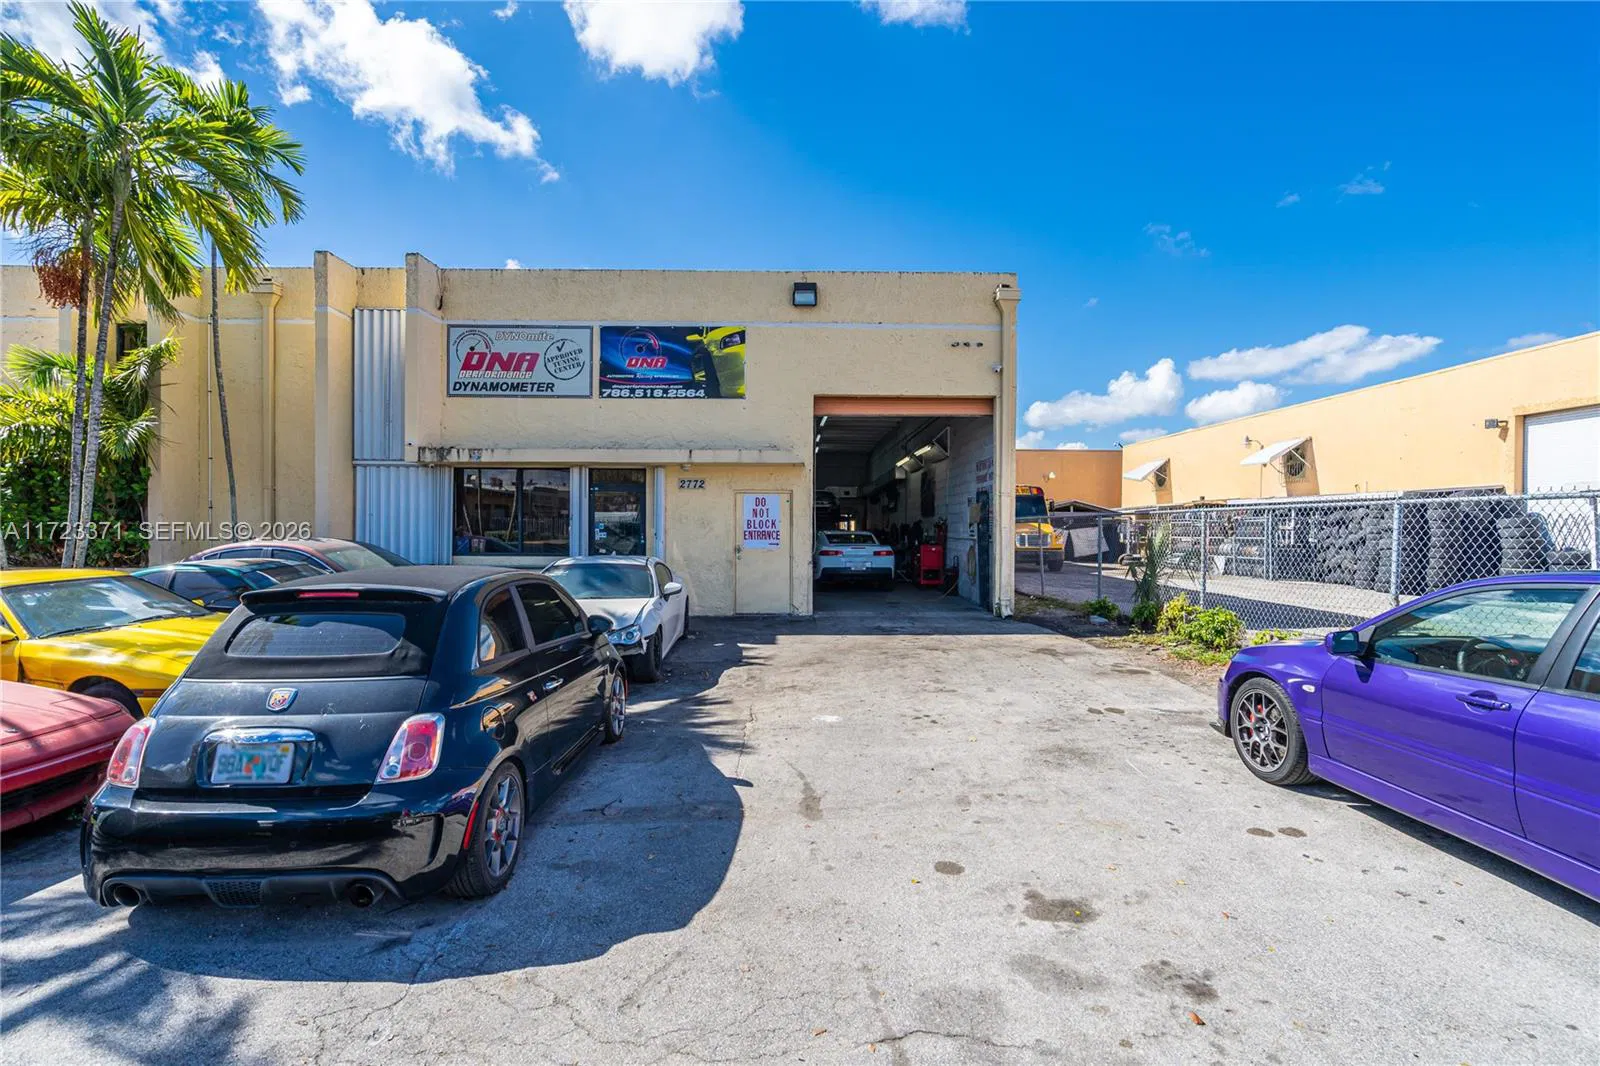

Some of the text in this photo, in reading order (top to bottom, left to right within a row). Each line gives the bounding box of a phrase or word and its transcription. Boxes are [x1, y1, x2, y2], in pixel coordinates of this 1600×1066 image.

[546, 348, 583, 363] APPROVED
[460, 352, 540, 371] DNA
[553, 356, 580, 368] TUNING
[626, 356, 668, 369] DNA
[553, 362, 582, 374] CENTER
[452, 381, 555, 392] DYNAMOMETER
[680, 480, 705, 489] 2772
[755, 497, 766, 507] DO
[752, 508, 769, 518] NOT
[746, 519, 777, 529] BLOCK
[743, 530, 780, 540] ENTRANCE
